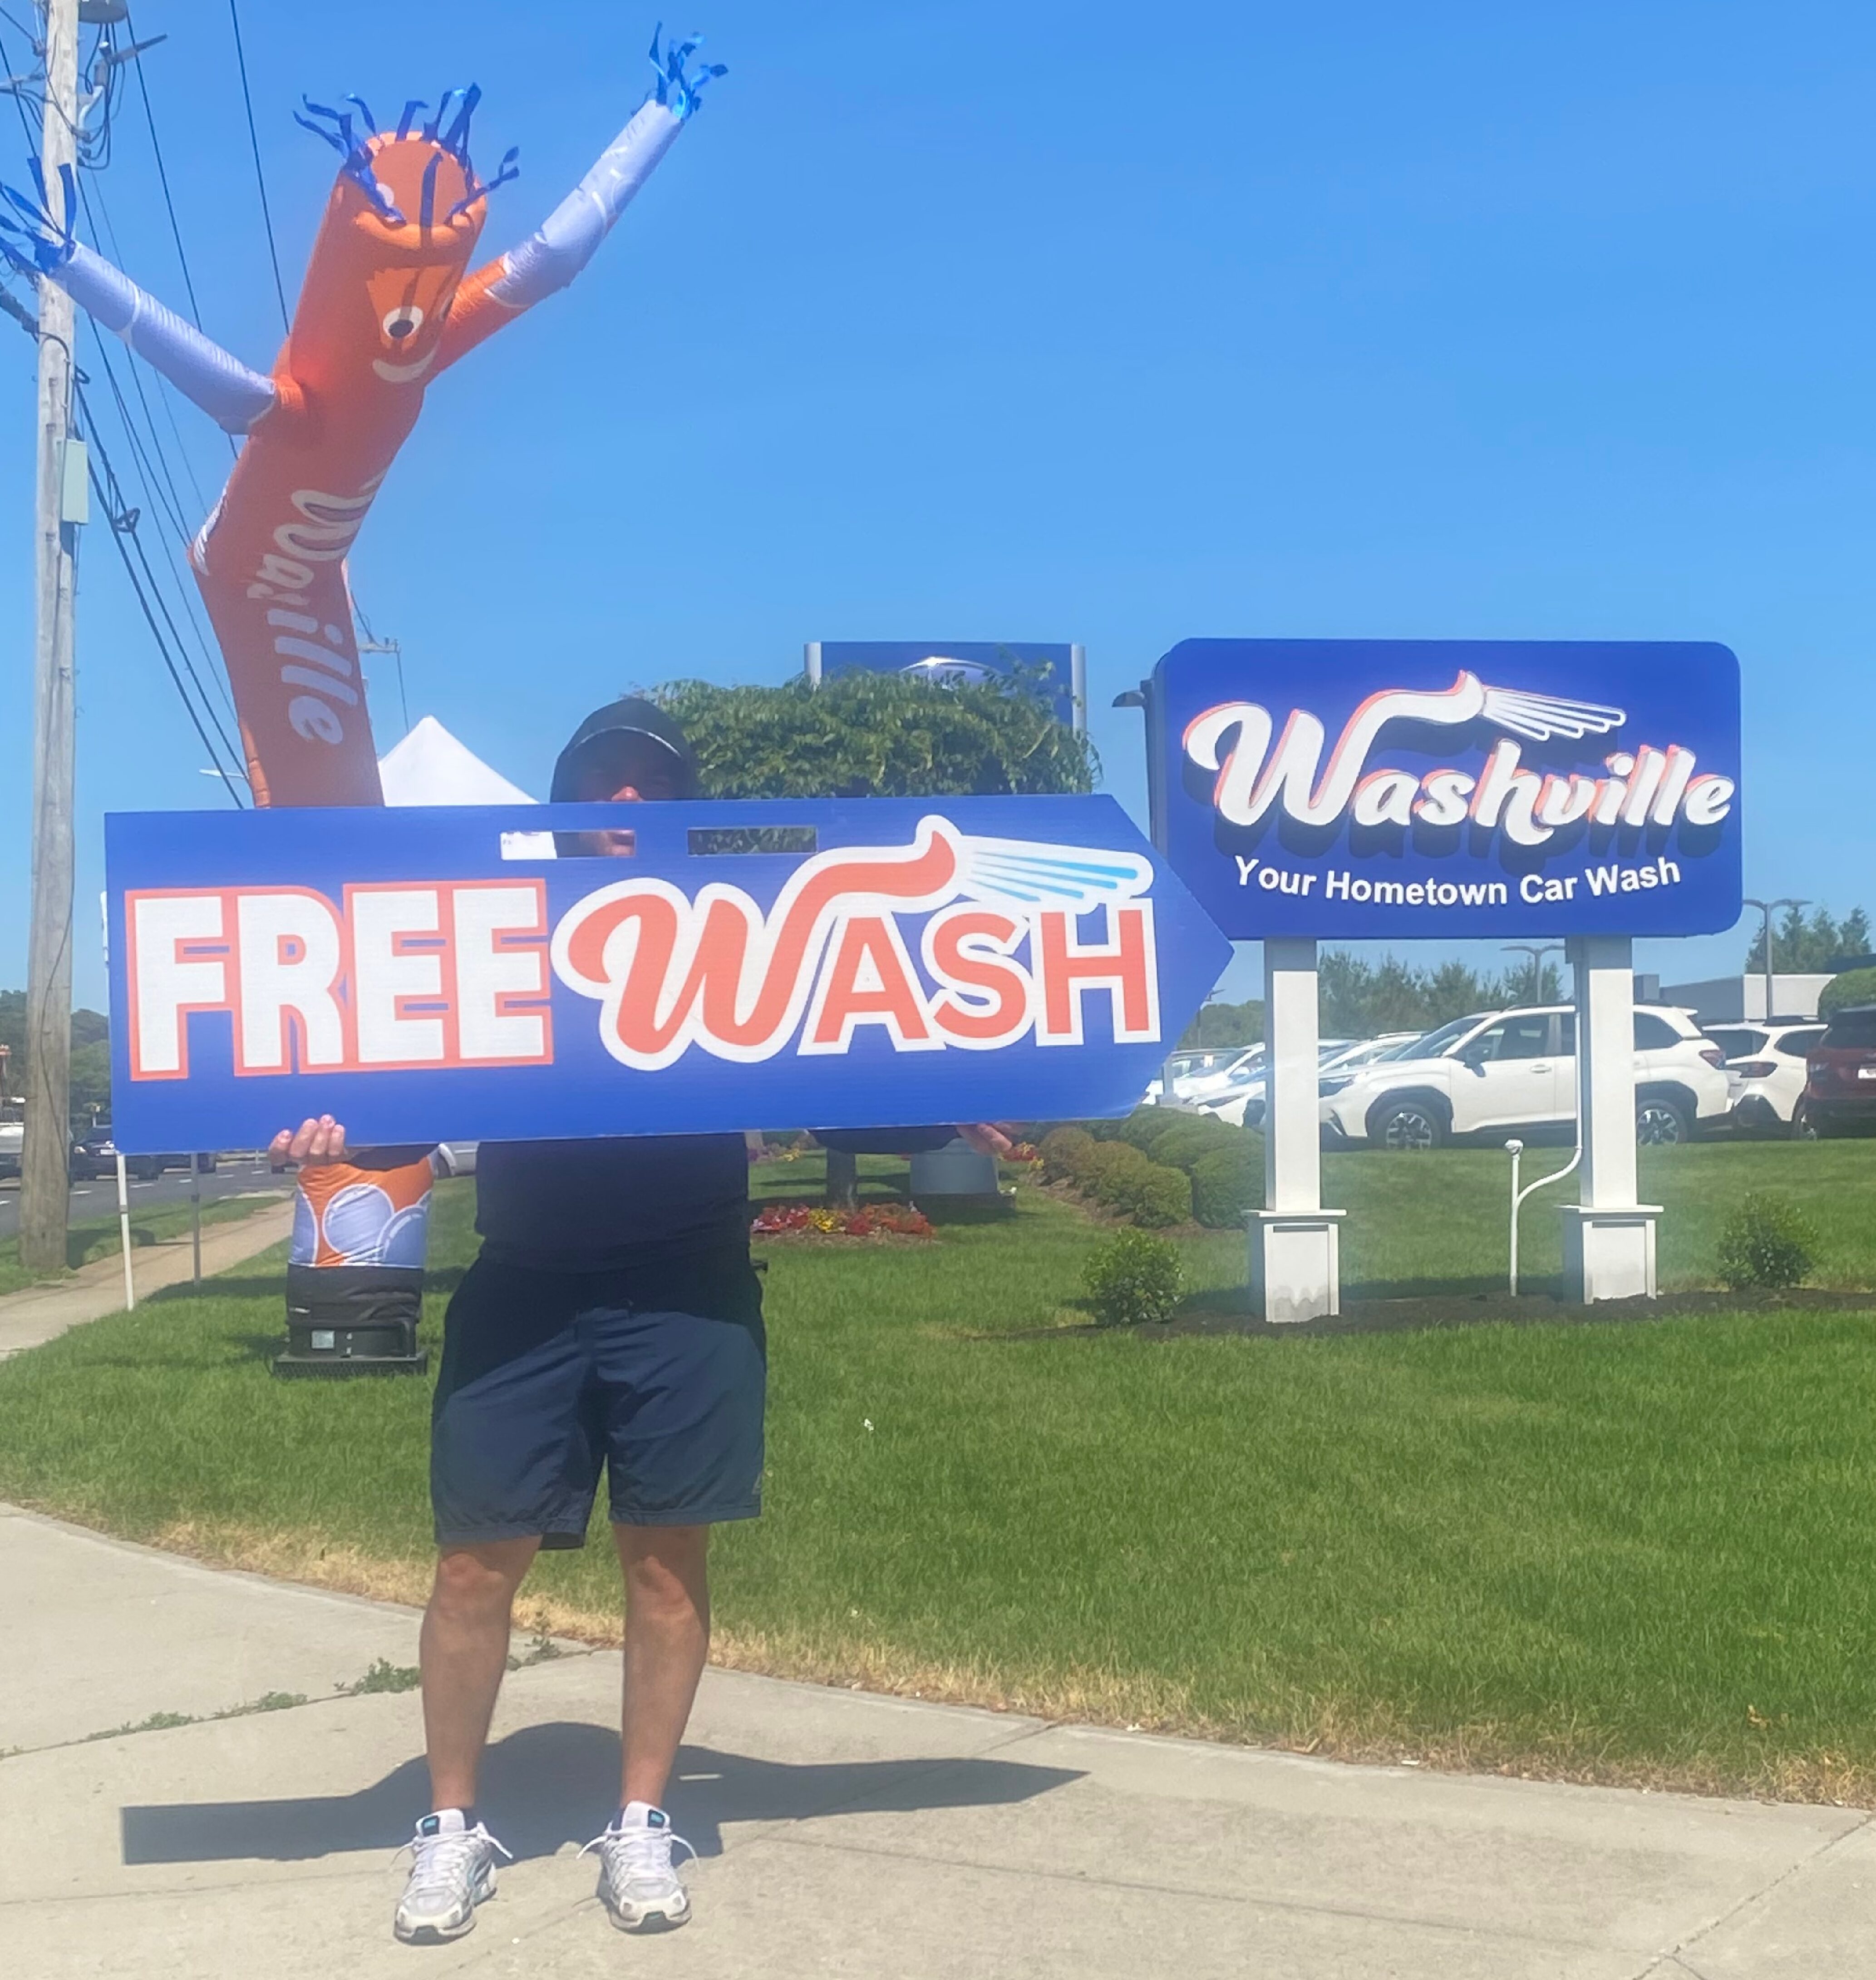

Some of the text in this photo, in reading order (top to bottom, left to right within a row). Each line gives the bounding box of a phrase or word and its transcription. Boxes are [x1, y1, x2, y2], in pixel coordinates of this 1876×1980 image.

[1182, 670, 1735, 845] Washville
[125, 815, 1161, 1081] FREE WASH
[1235, 855, 1680, 906] Your Hometown Car Wash
